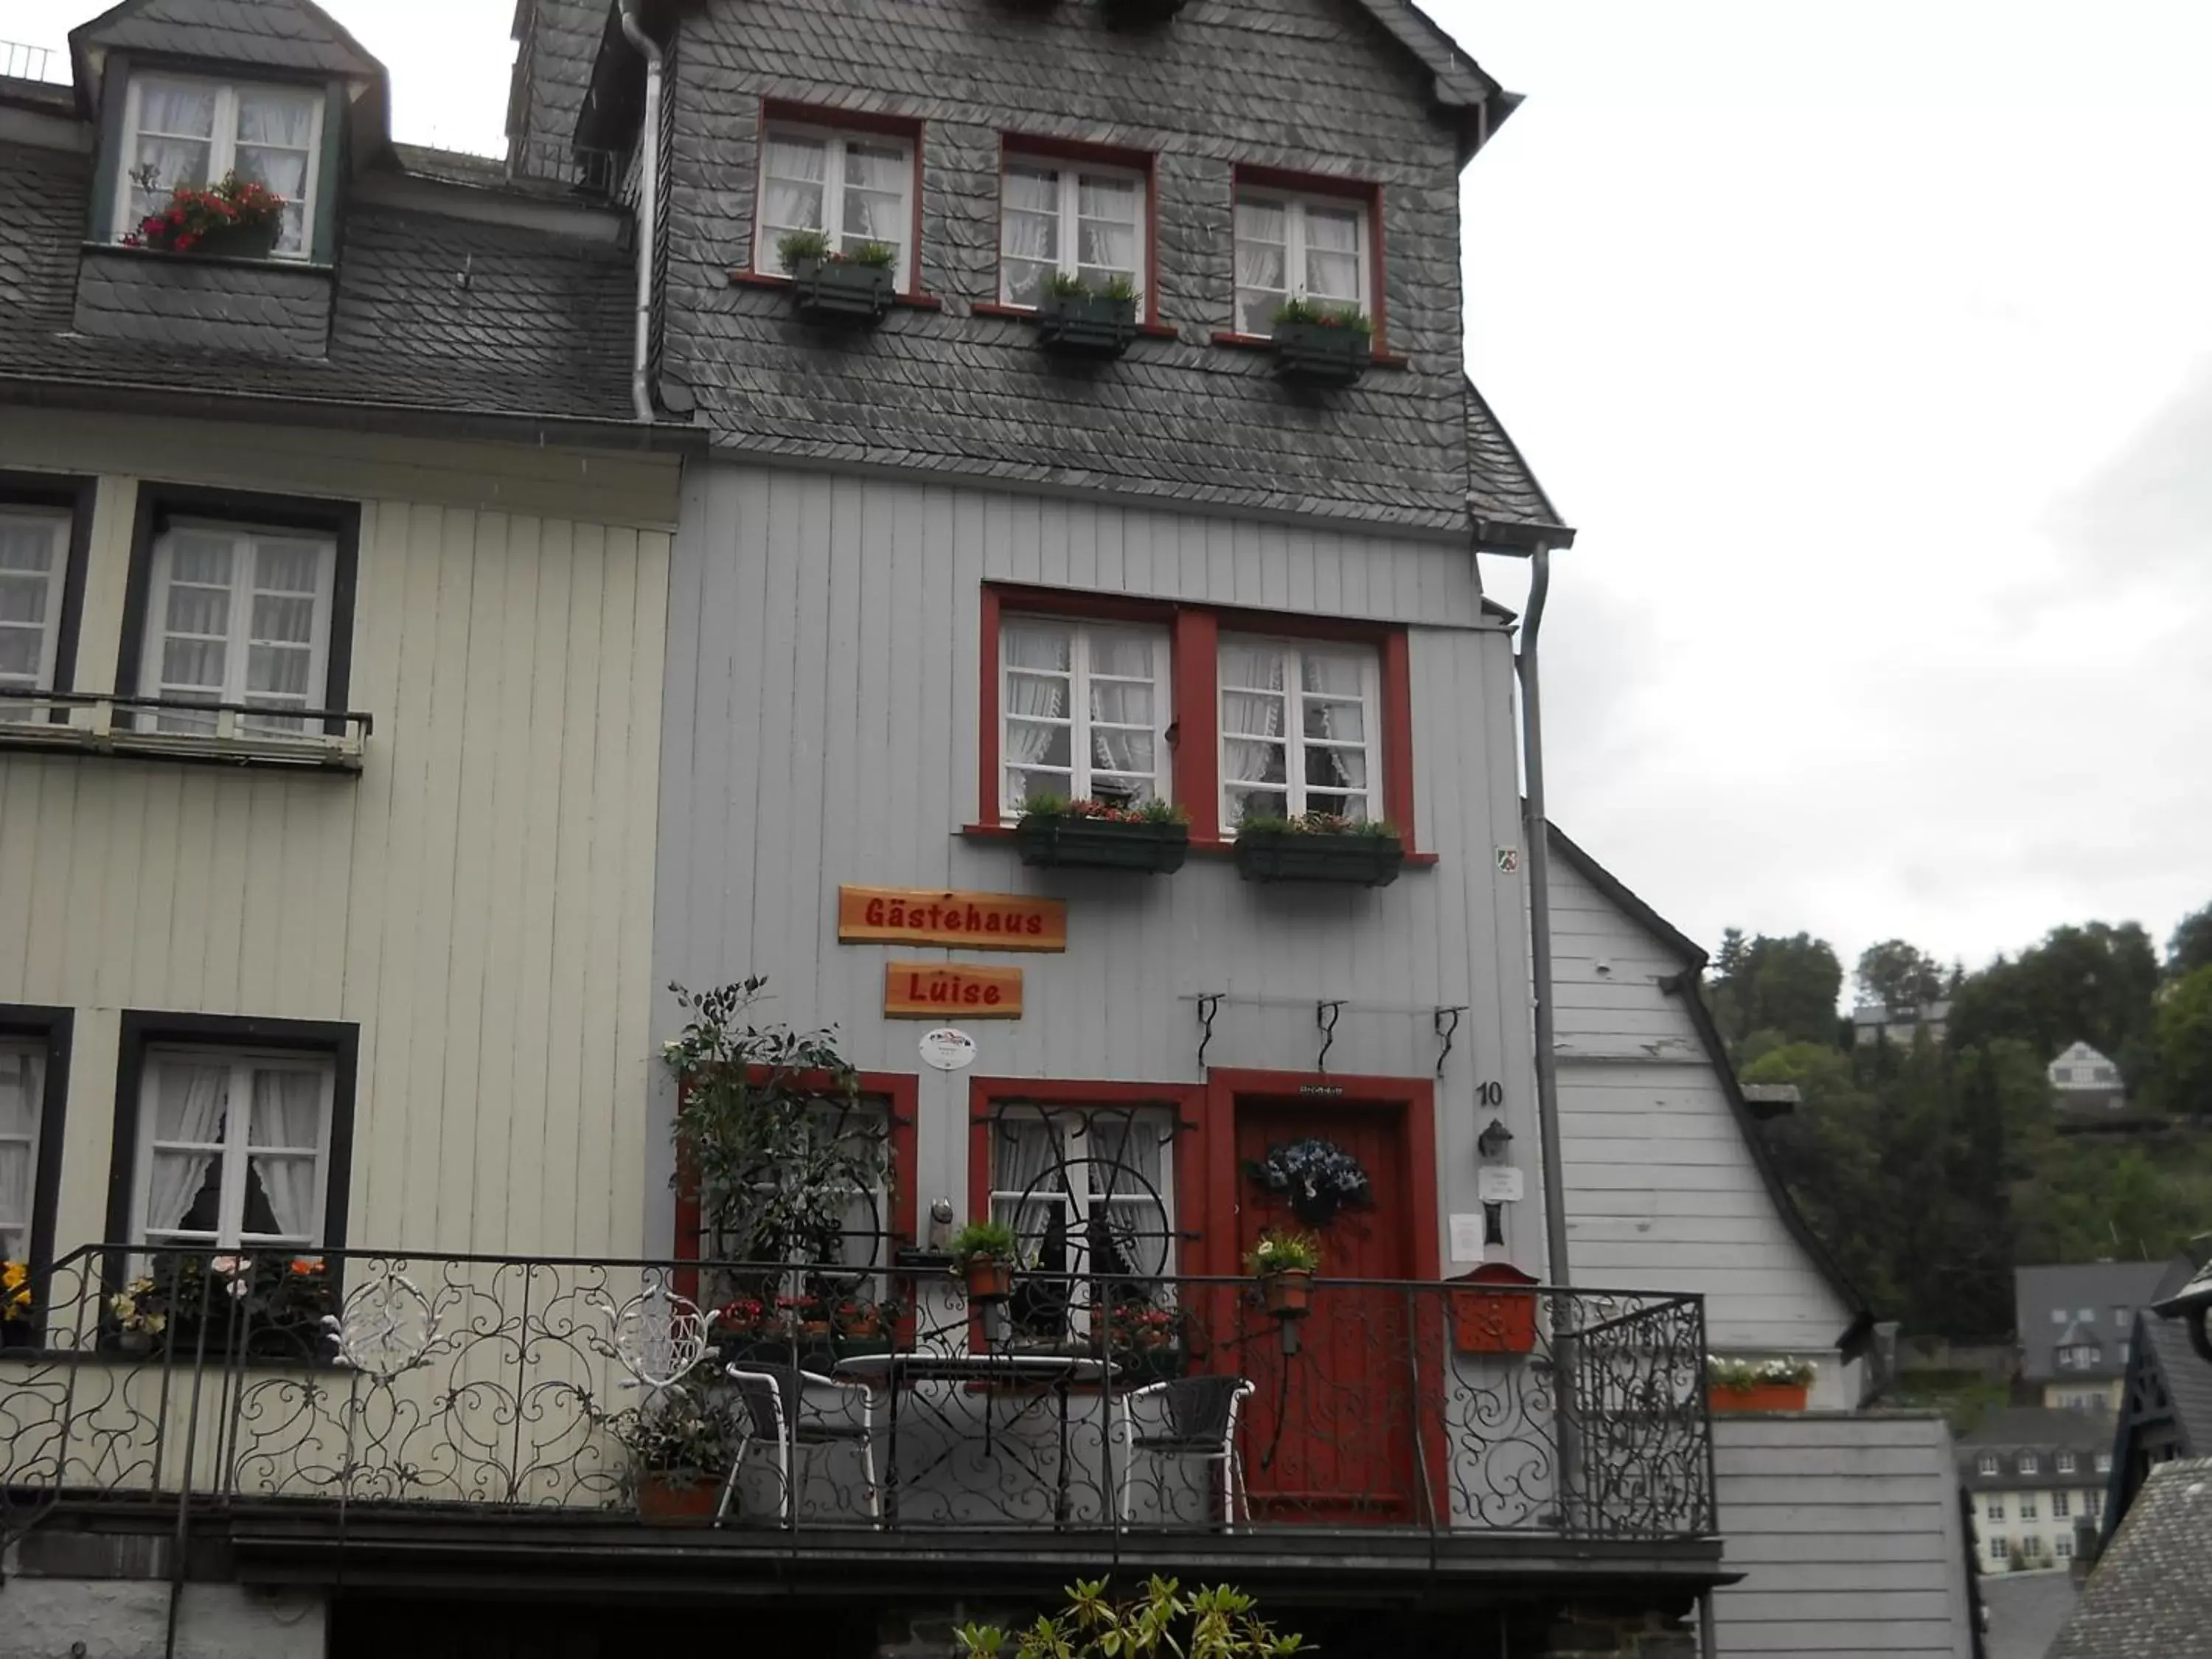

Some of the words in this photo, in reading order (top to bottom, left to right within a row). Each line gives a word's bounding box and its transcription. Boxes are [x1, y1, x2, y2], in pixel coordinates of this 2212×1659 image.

[865, 897, 1043, 935] Gästehaus
[908, 972, 1001, 1005] Luise
[1475, 1081, 1503, 1107] 10
